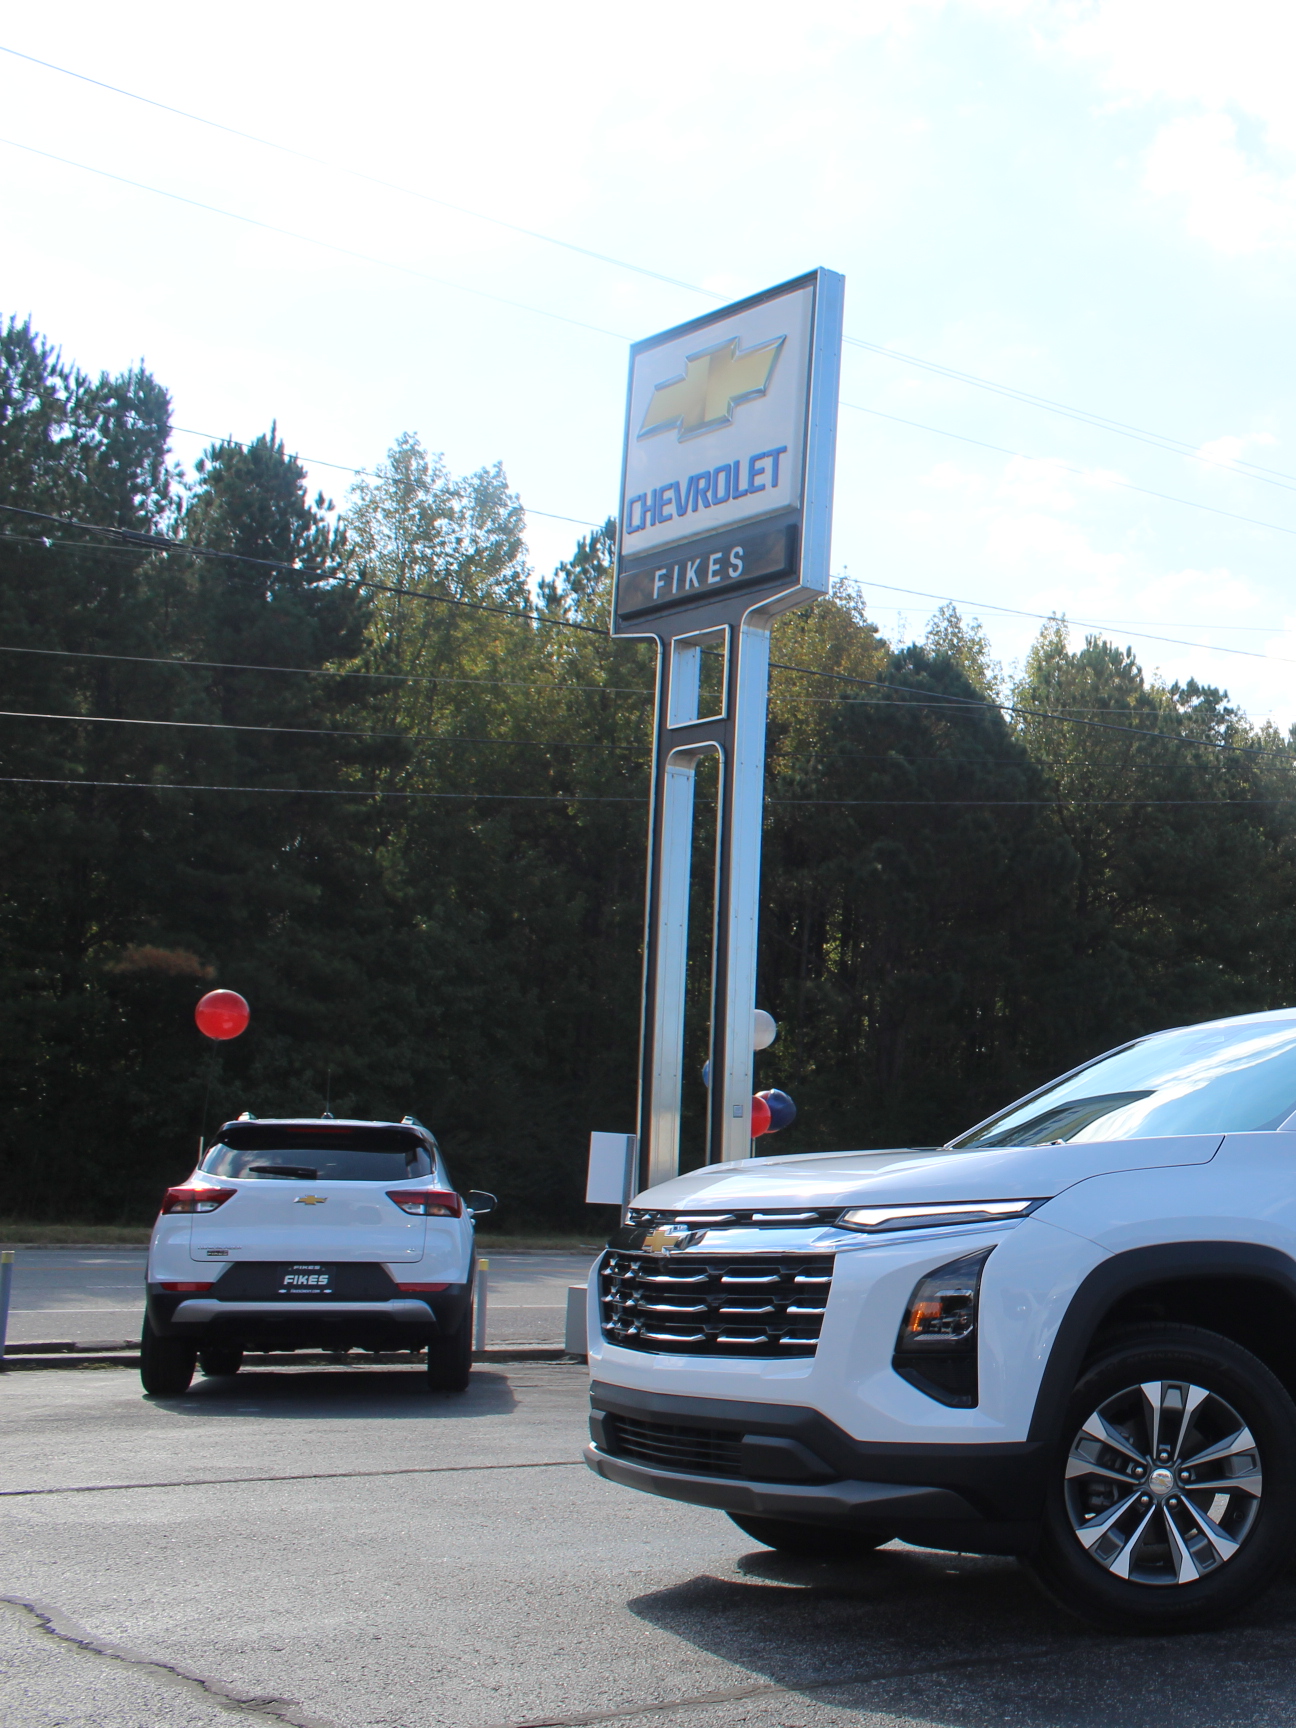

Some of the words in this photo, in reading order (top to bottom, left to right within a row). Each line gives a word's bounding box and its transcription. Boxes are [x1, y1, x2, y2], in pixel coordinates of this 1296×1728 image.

[626, 446, 788, 535] CHEVROLET
[653, 546, 745, 600] FIKES
[283, 1274, 329, 1285] FIKES
